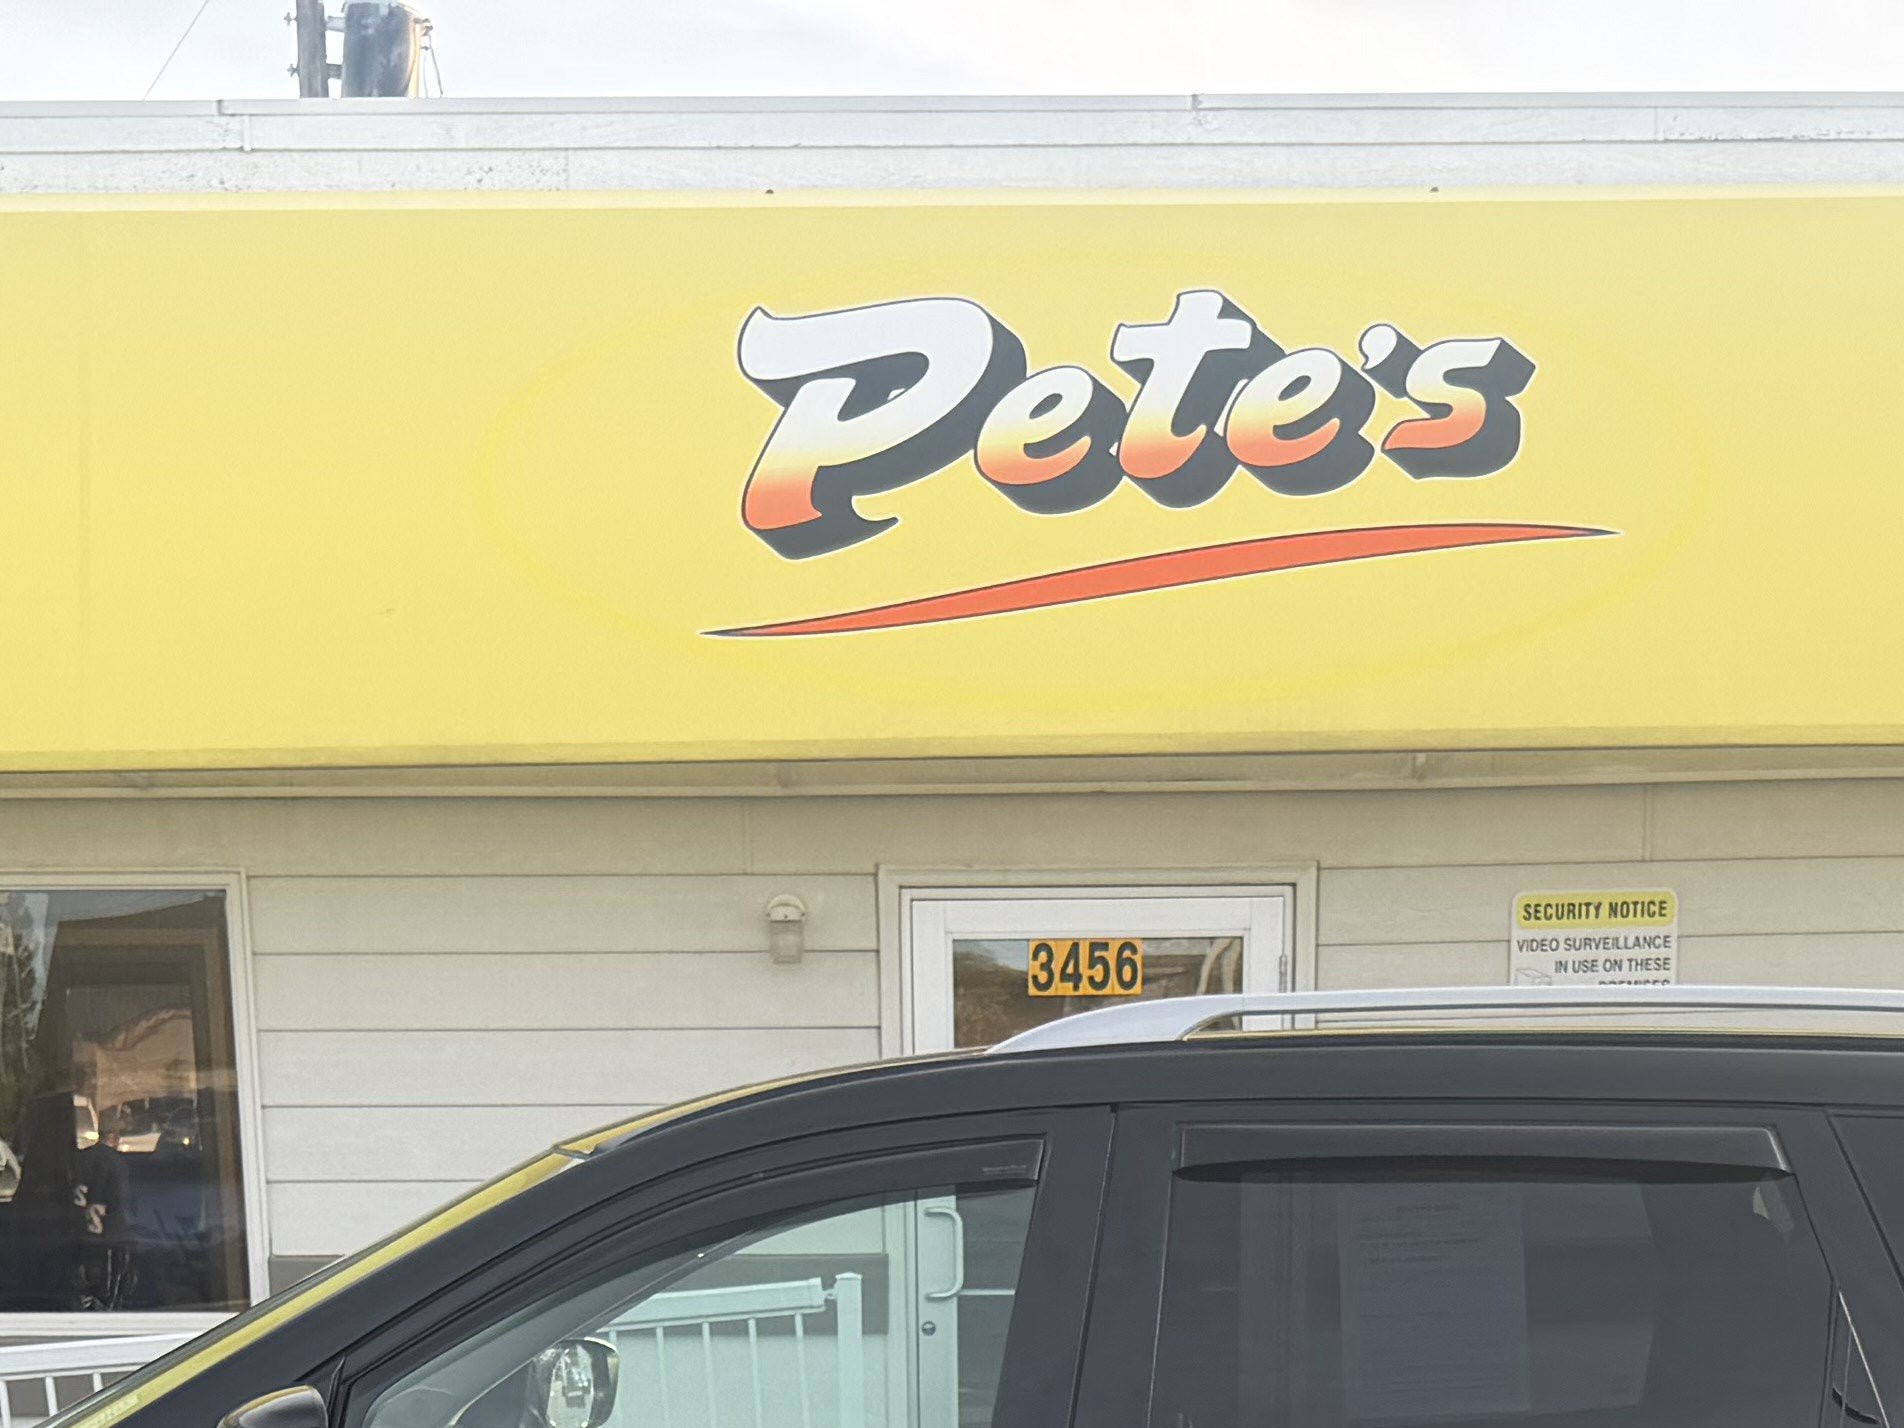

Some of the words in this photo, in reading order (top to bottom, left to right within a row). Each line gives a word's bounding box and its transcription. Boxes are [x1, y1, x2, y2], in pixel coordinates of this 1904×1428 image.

[736, 288, 1532, 556] Pete's
[1523, 901, 1601, 921] SECURITY
[1608, 899, 1668, 919] NOTICE
[1517, 938, 1560, 953] VIDEO
[1563, 935, 1672, 951] SURVEILLANCE
[1031, 941, 1139, 992] 3456
[1554, 960, 1568, 973] IN
[1572, 959, 1598, 974] USE
[1602, 959, 1623, 973] ON
[1627, 957, 1671, 972] THESE
